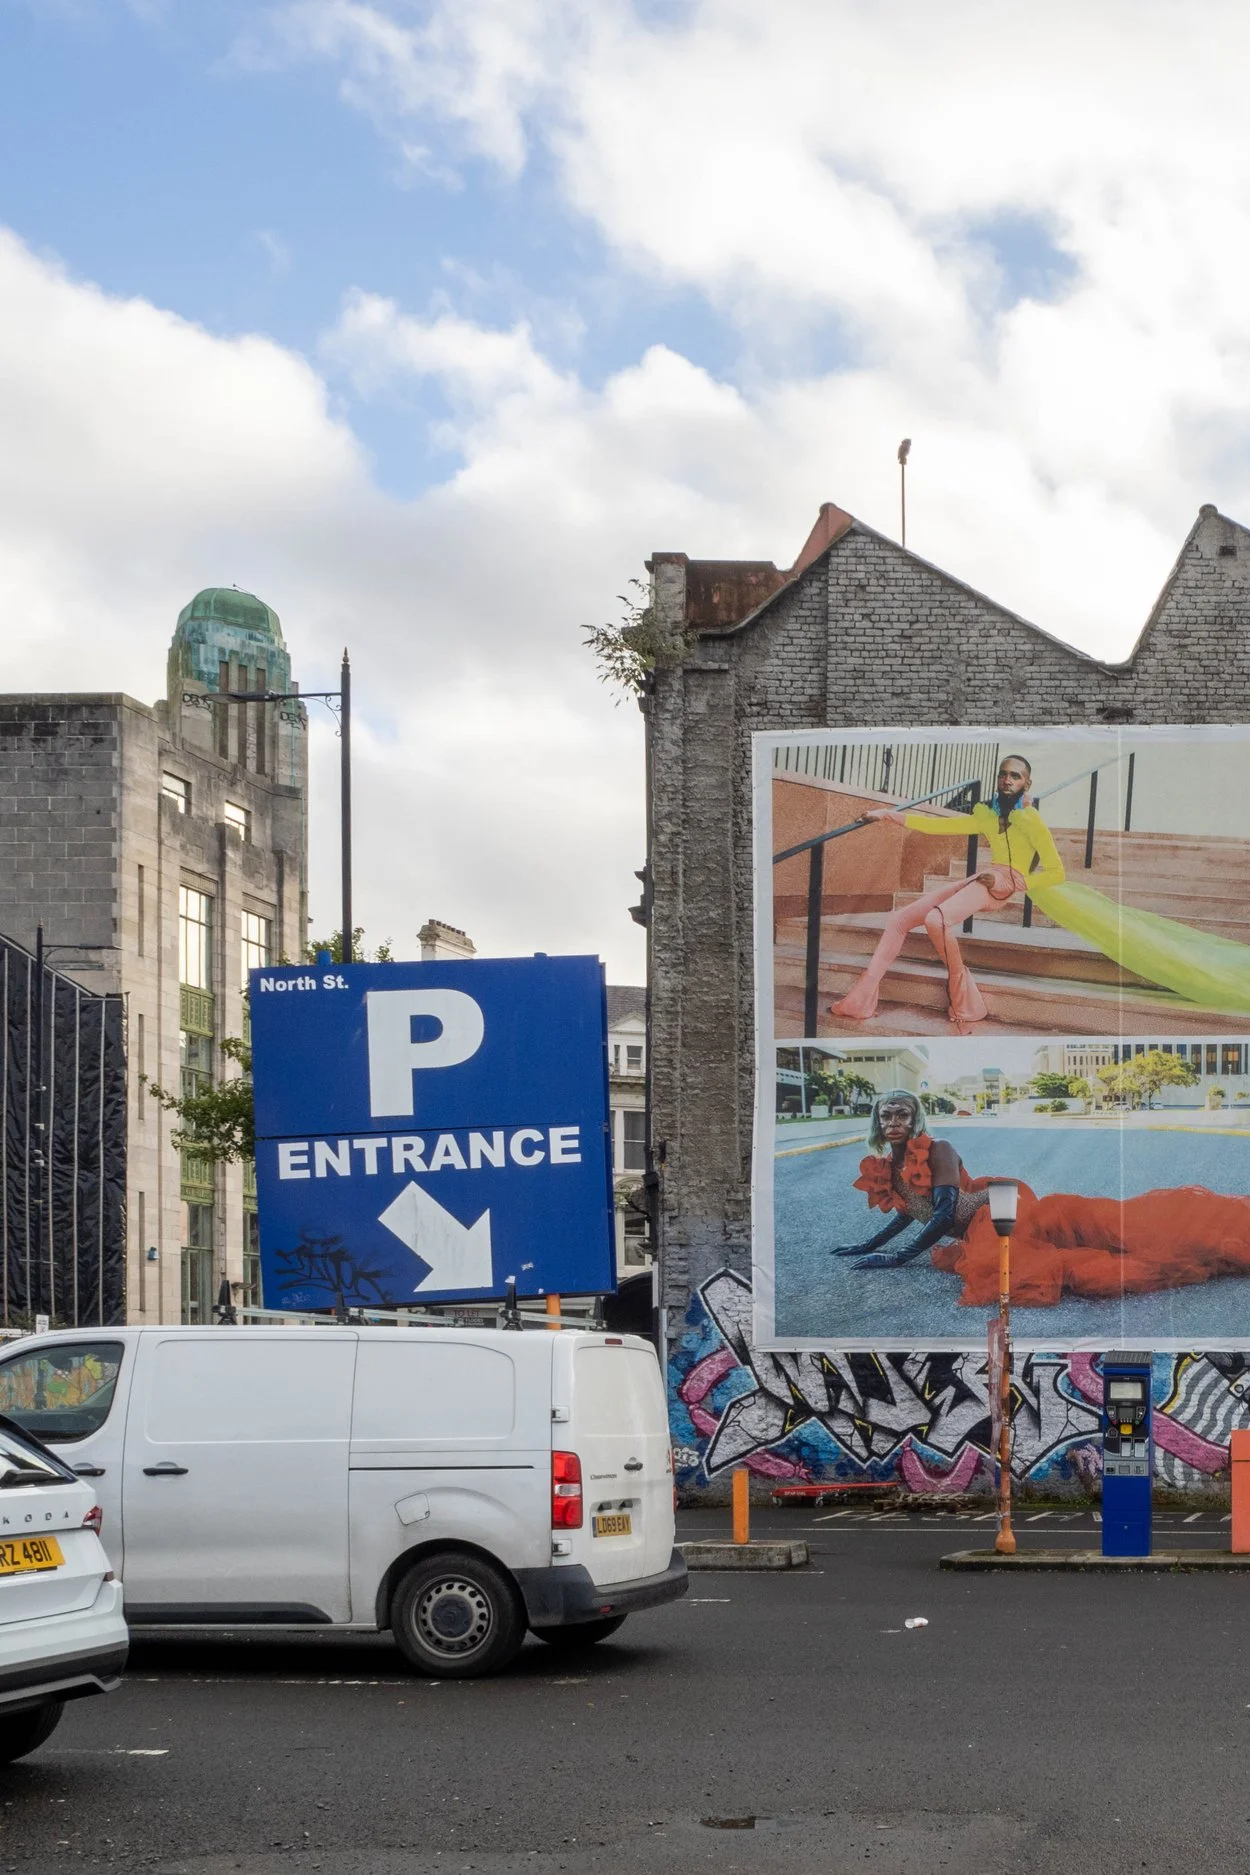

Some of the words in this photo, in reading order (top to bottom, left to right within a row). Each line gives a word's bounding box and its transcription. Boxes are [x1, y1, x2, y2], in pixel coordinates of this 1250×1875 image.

[260, 976, 317, 992] North
[322, 974, 349, 990] St.
[367, 988, 485, 1118] P
[277, 1125, 582, 1180] ENTRANCE
[22, 1539, 53, 1564] 4811
